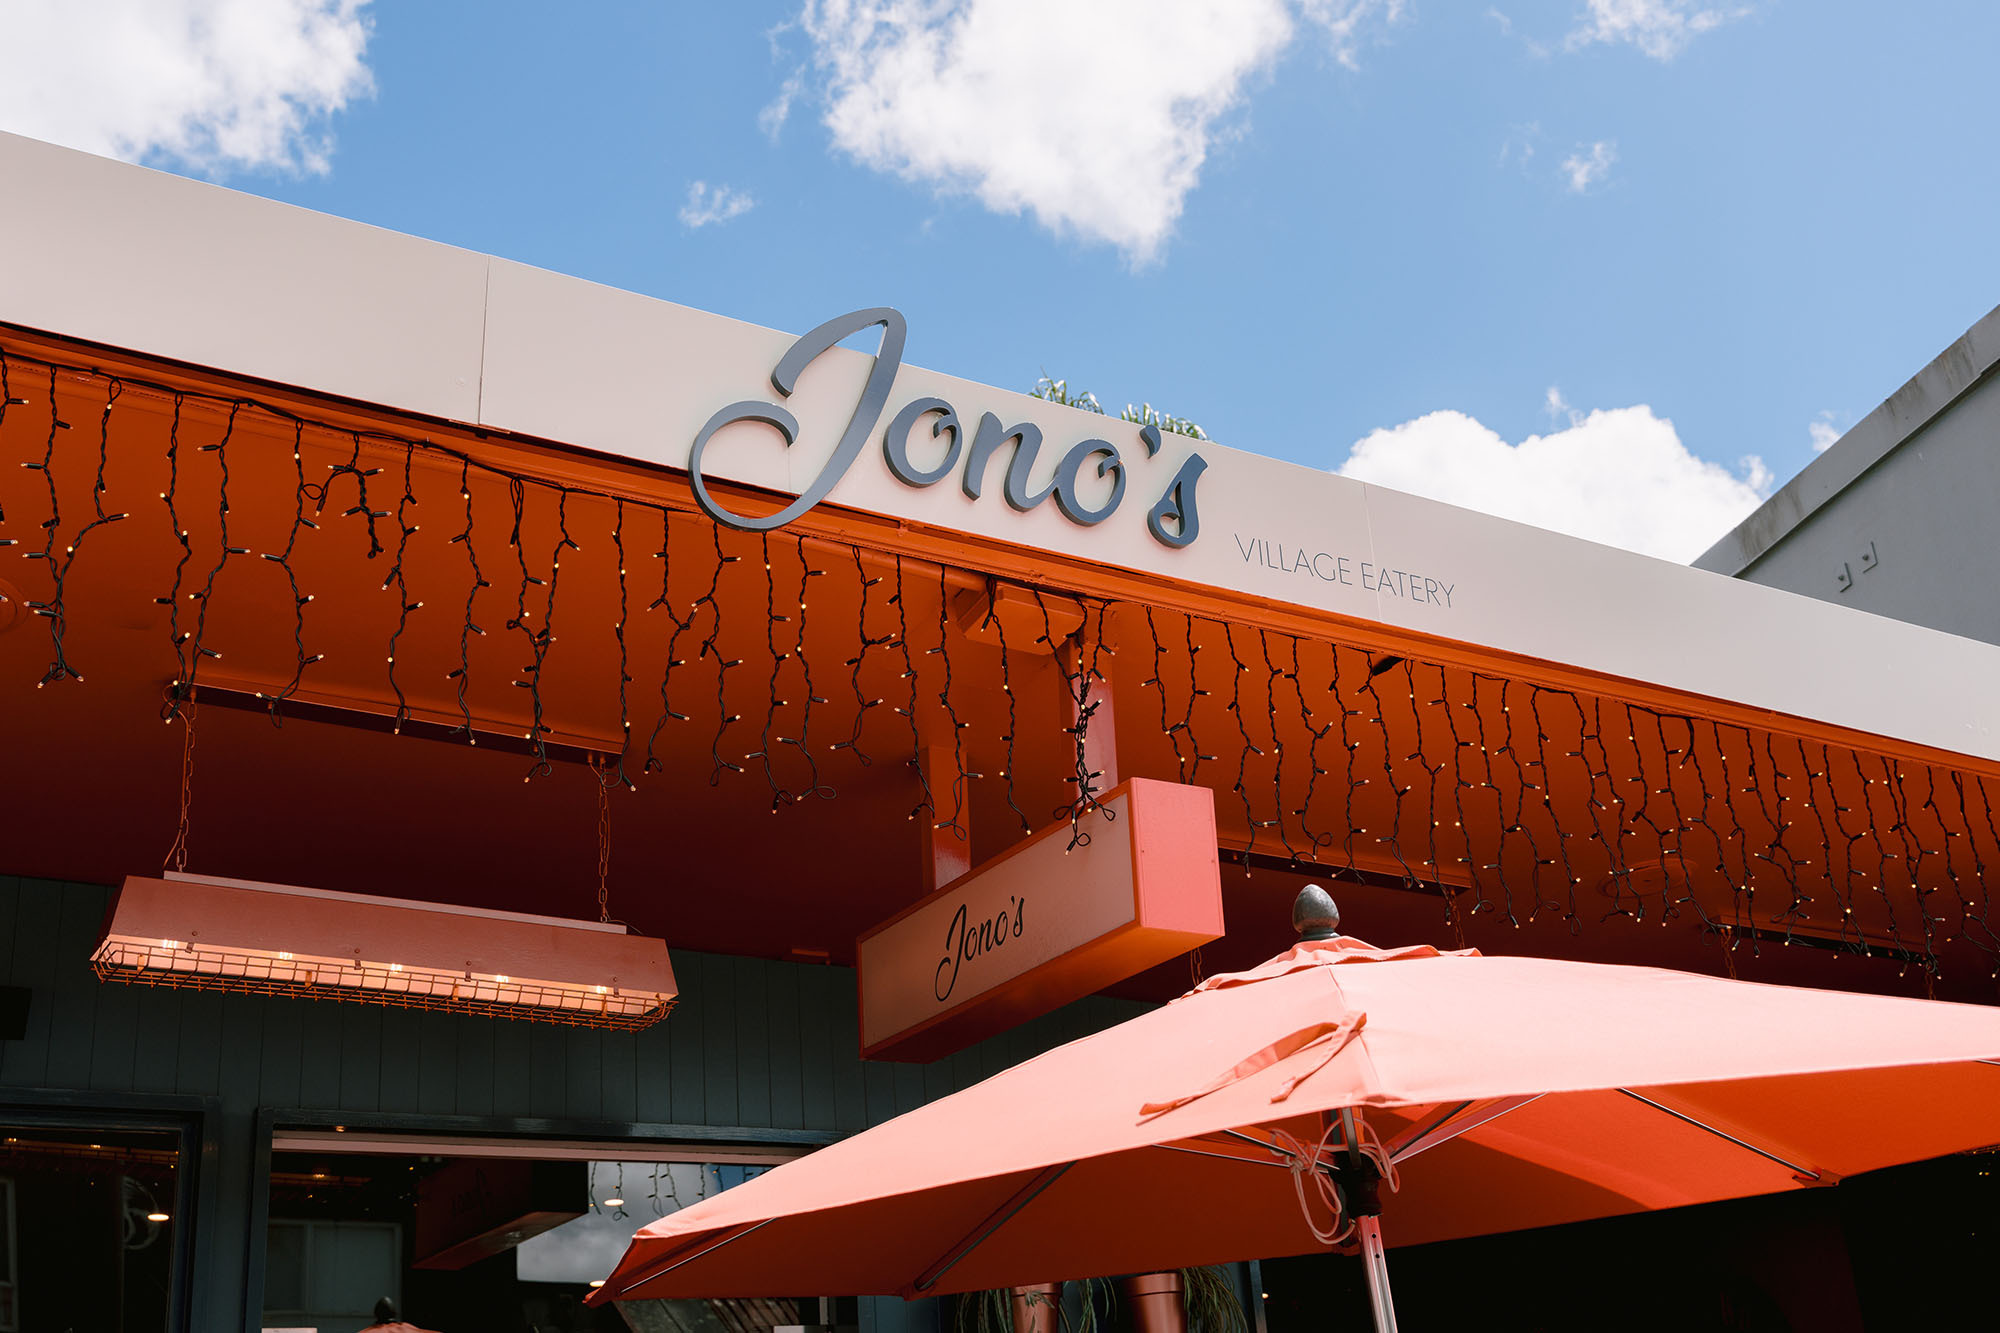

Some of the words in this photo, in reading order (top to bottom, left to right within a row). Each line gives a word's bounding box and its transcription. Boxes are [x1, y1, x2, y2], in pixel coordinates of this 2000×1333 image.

[688, 306, 1209, 550] Jono's
[1234, 533, 1353, 586] VILLAGE
[1361, 562, 1455, 609] EATERY
[934, 895, 1025, 1002] Jono's
